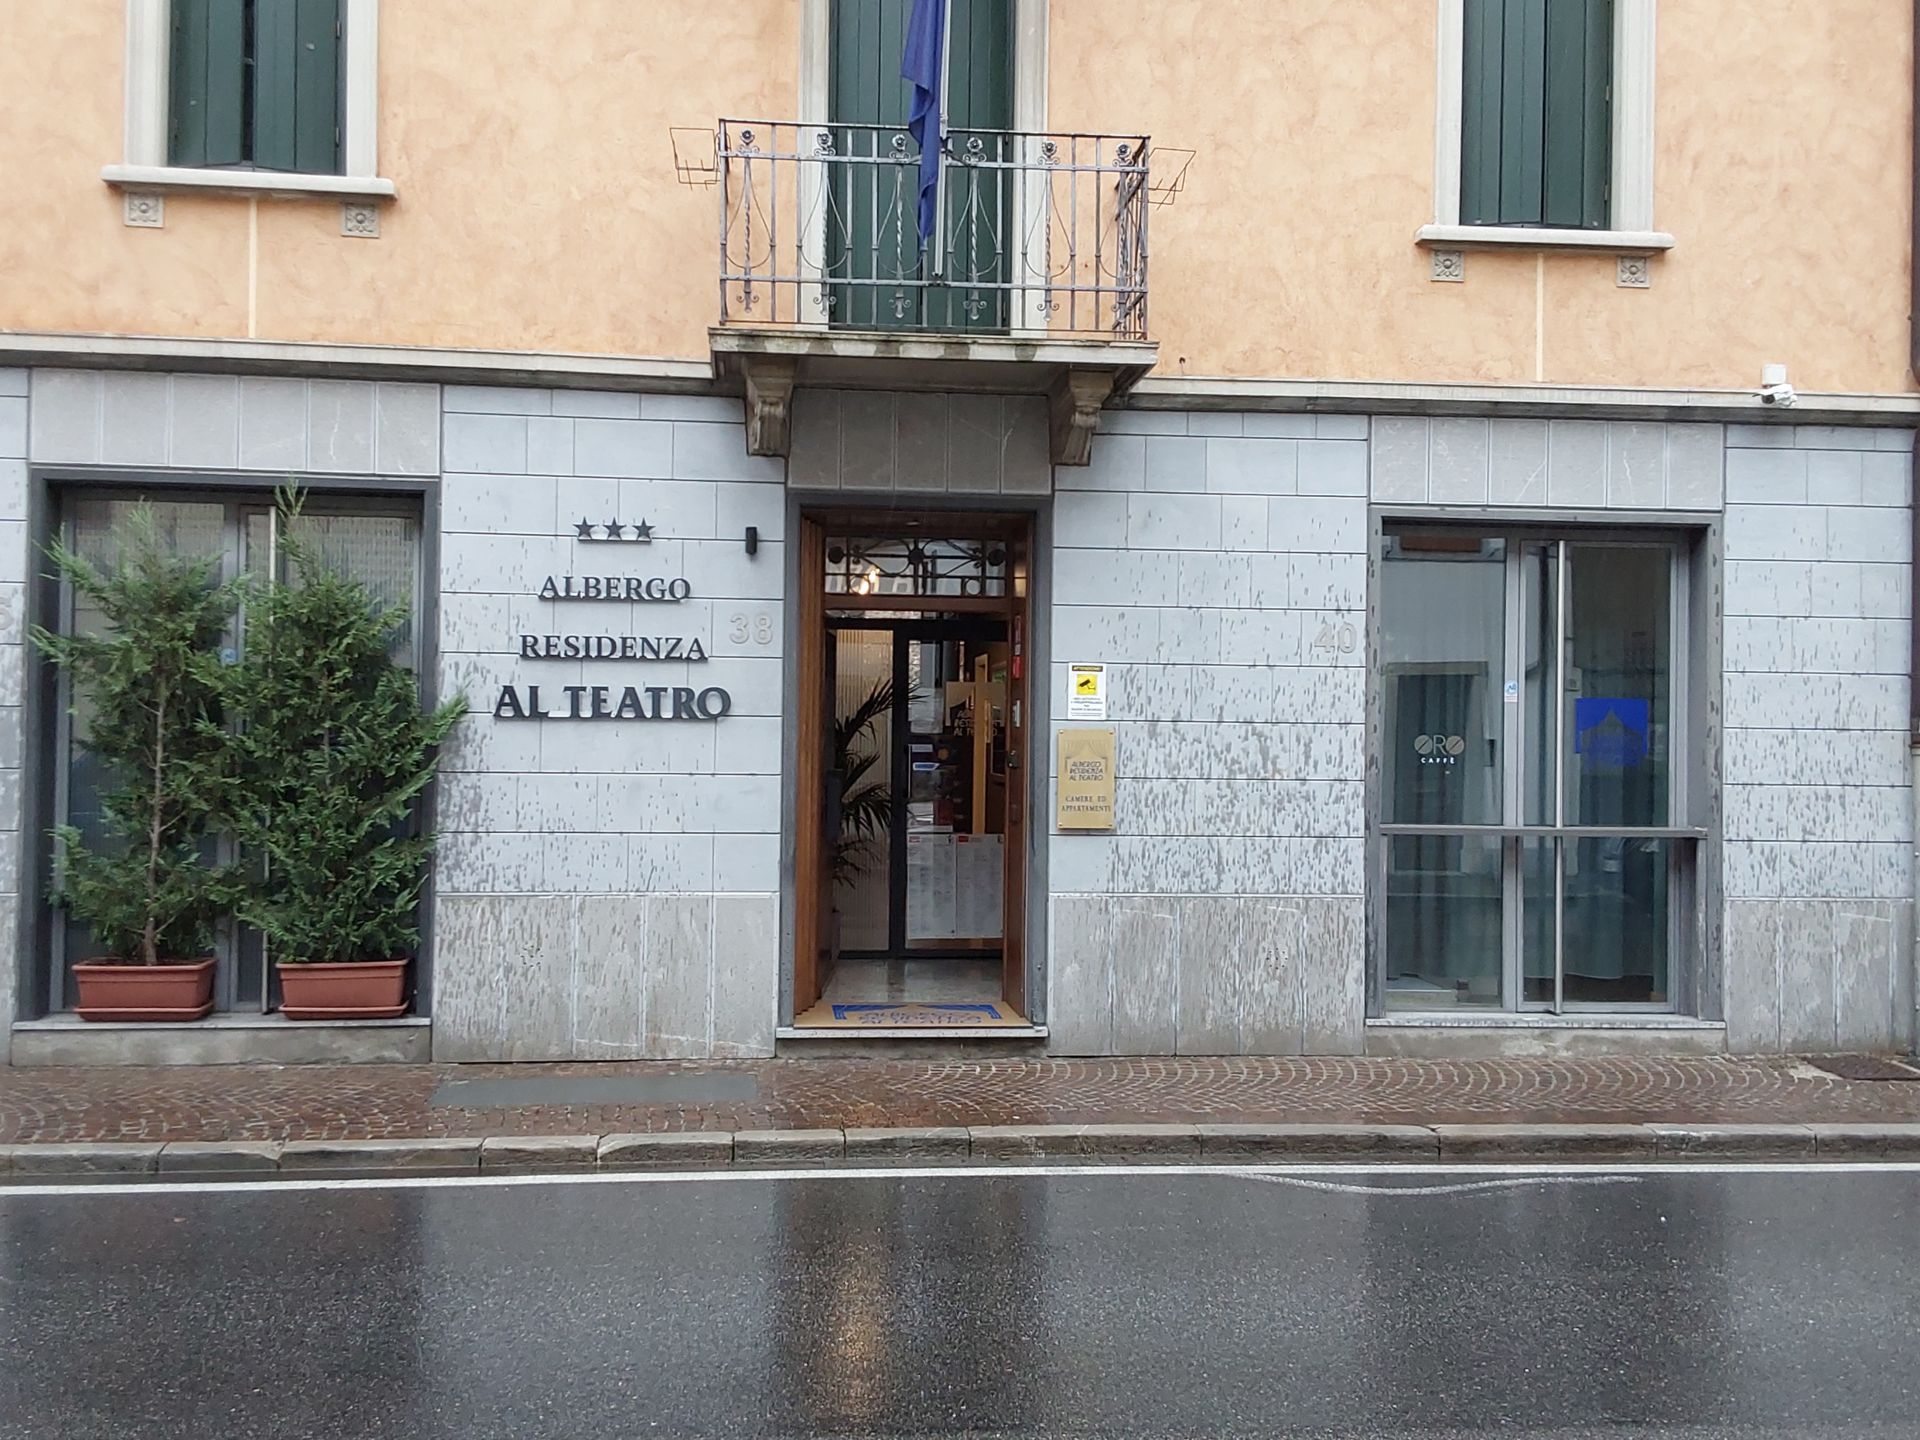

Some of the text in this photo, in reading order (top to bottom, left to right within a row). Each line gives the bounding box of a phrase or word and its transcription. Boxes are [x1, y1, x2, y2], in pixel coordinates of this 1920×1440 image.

[538, 576, 691, 601] ALBERGO
[729, 612, 774, 645] 38
[1313, 622, 1358, 654] 40
[520, 634, 708, 661] RESIDENZA
[494, 685, 731, 720] AL TEATRO
[1414, 734, 1465, 755] ORO
